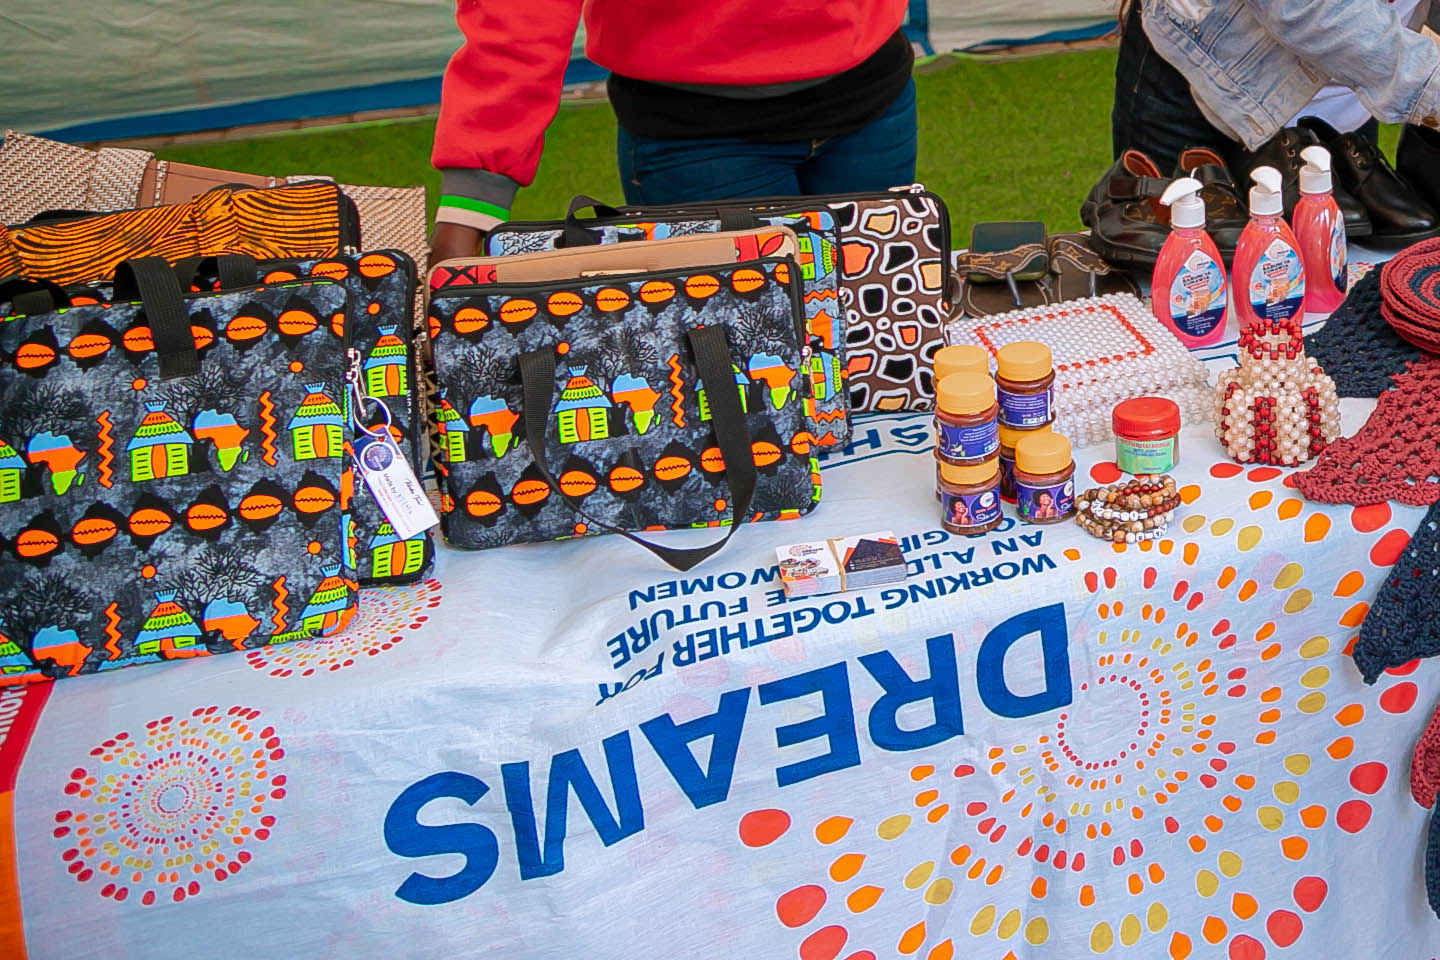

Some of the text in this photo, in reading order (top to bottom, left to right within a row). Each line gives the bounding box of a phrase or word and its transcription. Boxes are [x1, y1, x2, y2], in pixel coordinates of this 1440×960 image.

[991, 530, 1043, 556] AN
[628, 565, 783, 611] WOMEN
[880, 553, 1058, 610] WORKING
[606, 596, 749, 669] FUTURE
[672, 596, 875, 668] TOGETHER
[382, 601, 1074, 906] DREAMS
